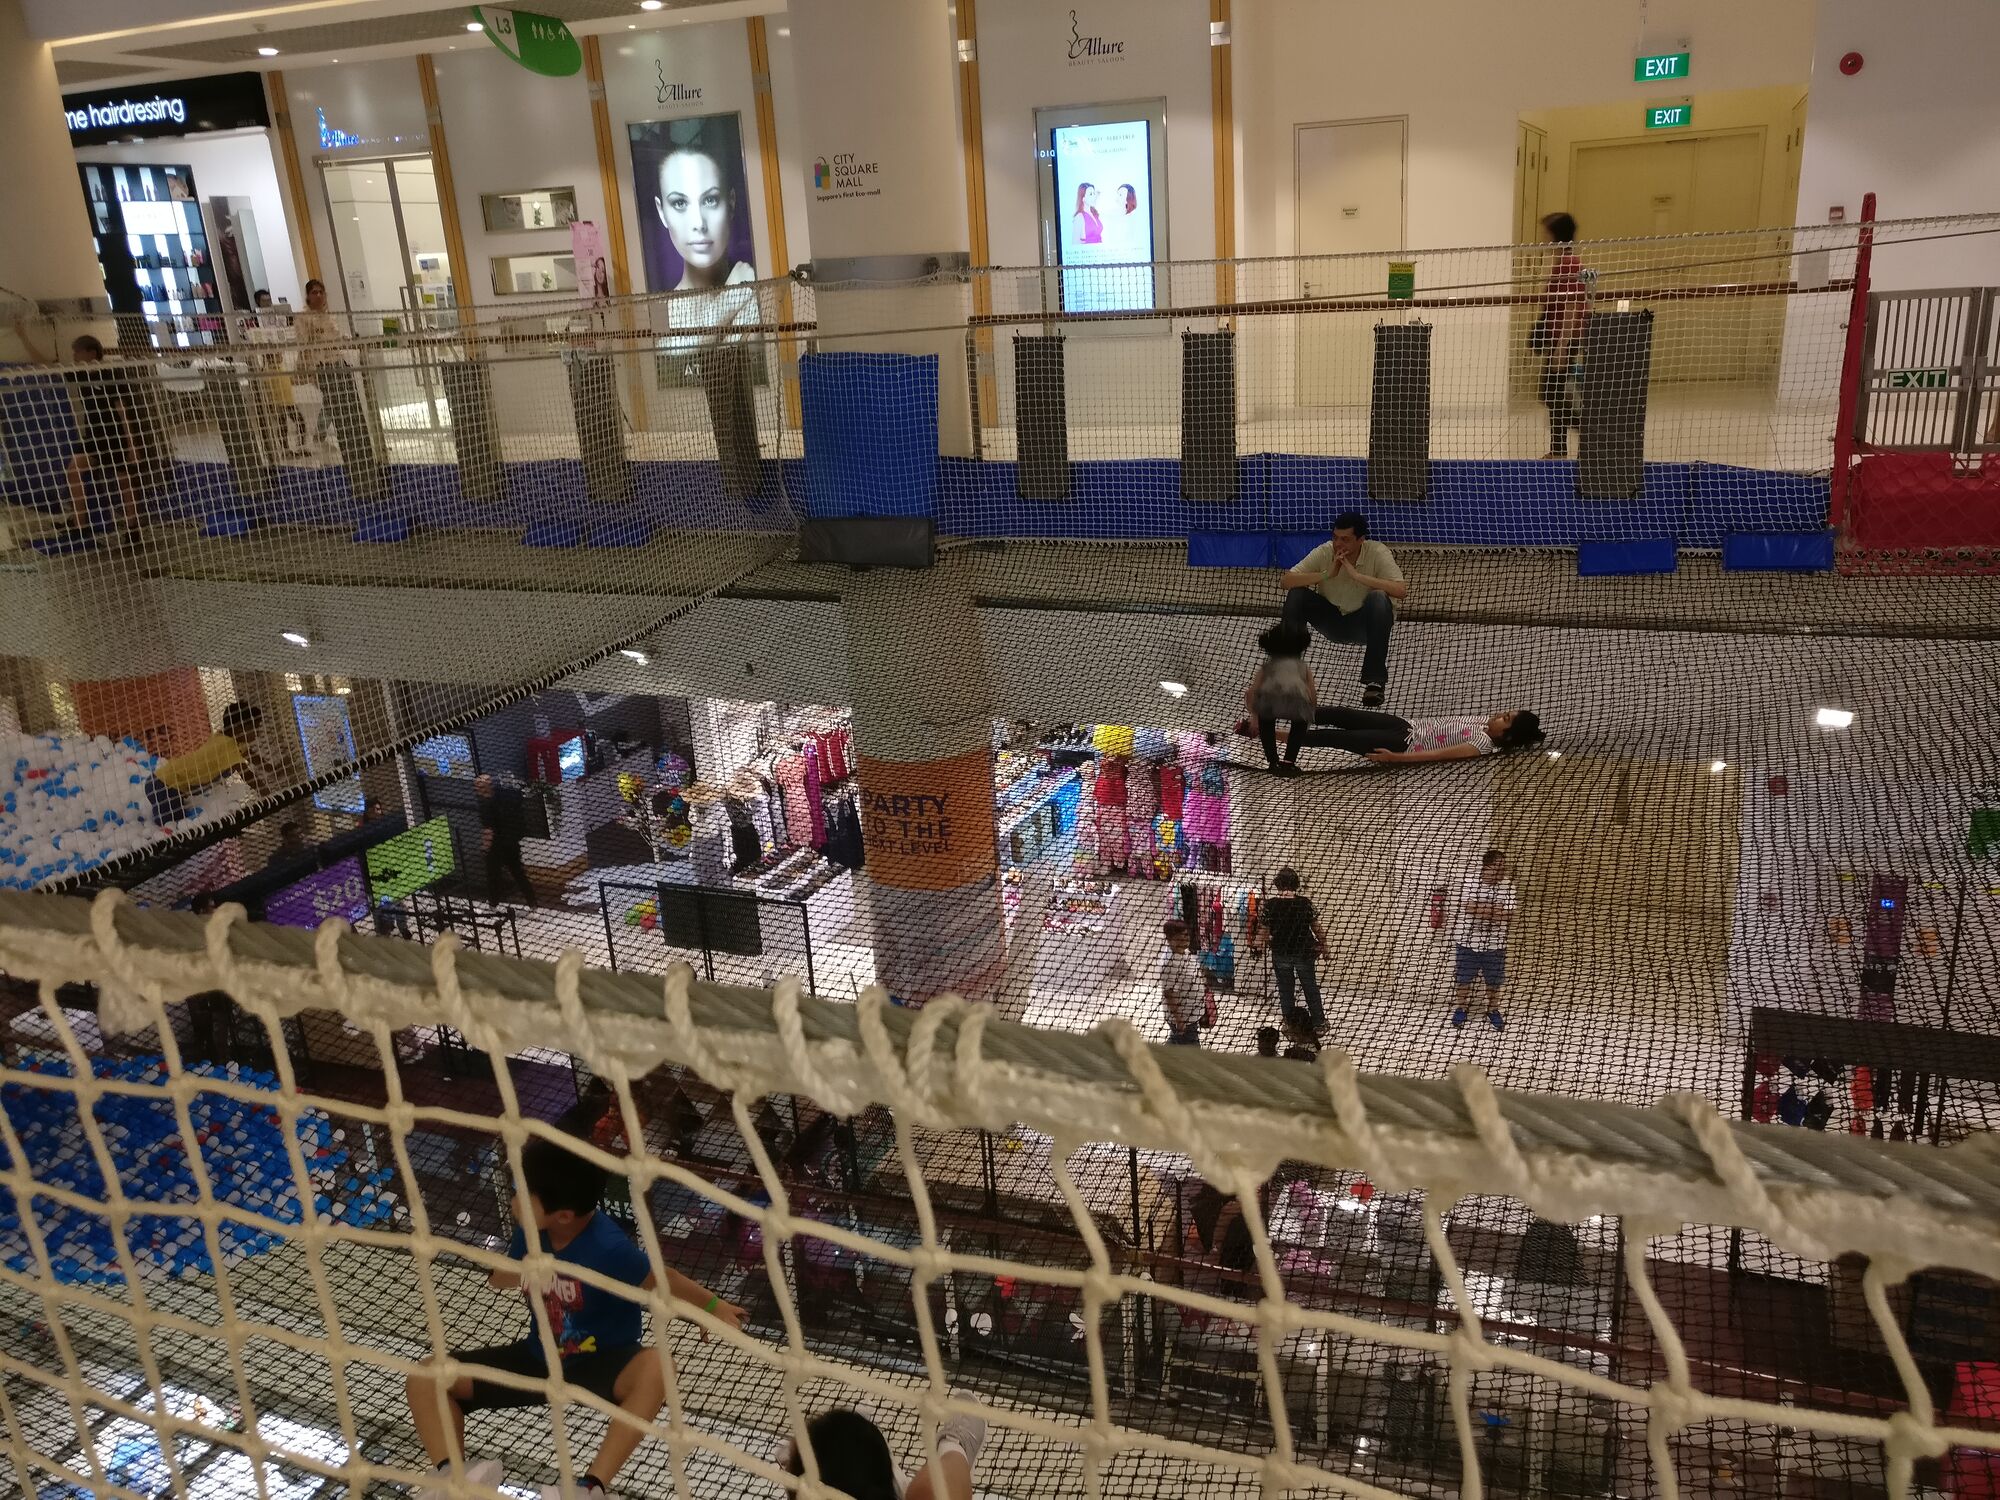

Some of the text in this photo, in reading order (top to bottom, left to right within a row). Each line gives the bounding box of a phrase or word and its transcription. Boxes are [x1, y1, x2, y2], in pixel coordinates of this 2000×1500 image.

[496, 15, 512, 35] L3
[1068, 37, 1125, 59] Allure
[1645, 56, 1679, 77] EXIT
[657, 83, 703, 103] Allure
[88, 94, 185, 127] hairdressing
[1654, 108, 1682, 125] EXIT
[833, 153, 855, 165] CITY
[834, 163, 879, 177] SQUARE
[836, 176, 864, 189] MALL
[1889, 370, 1946, 389] EXIT
[863, 789, 949, 817] PARTY
[899, 816, 953, 839] THE
